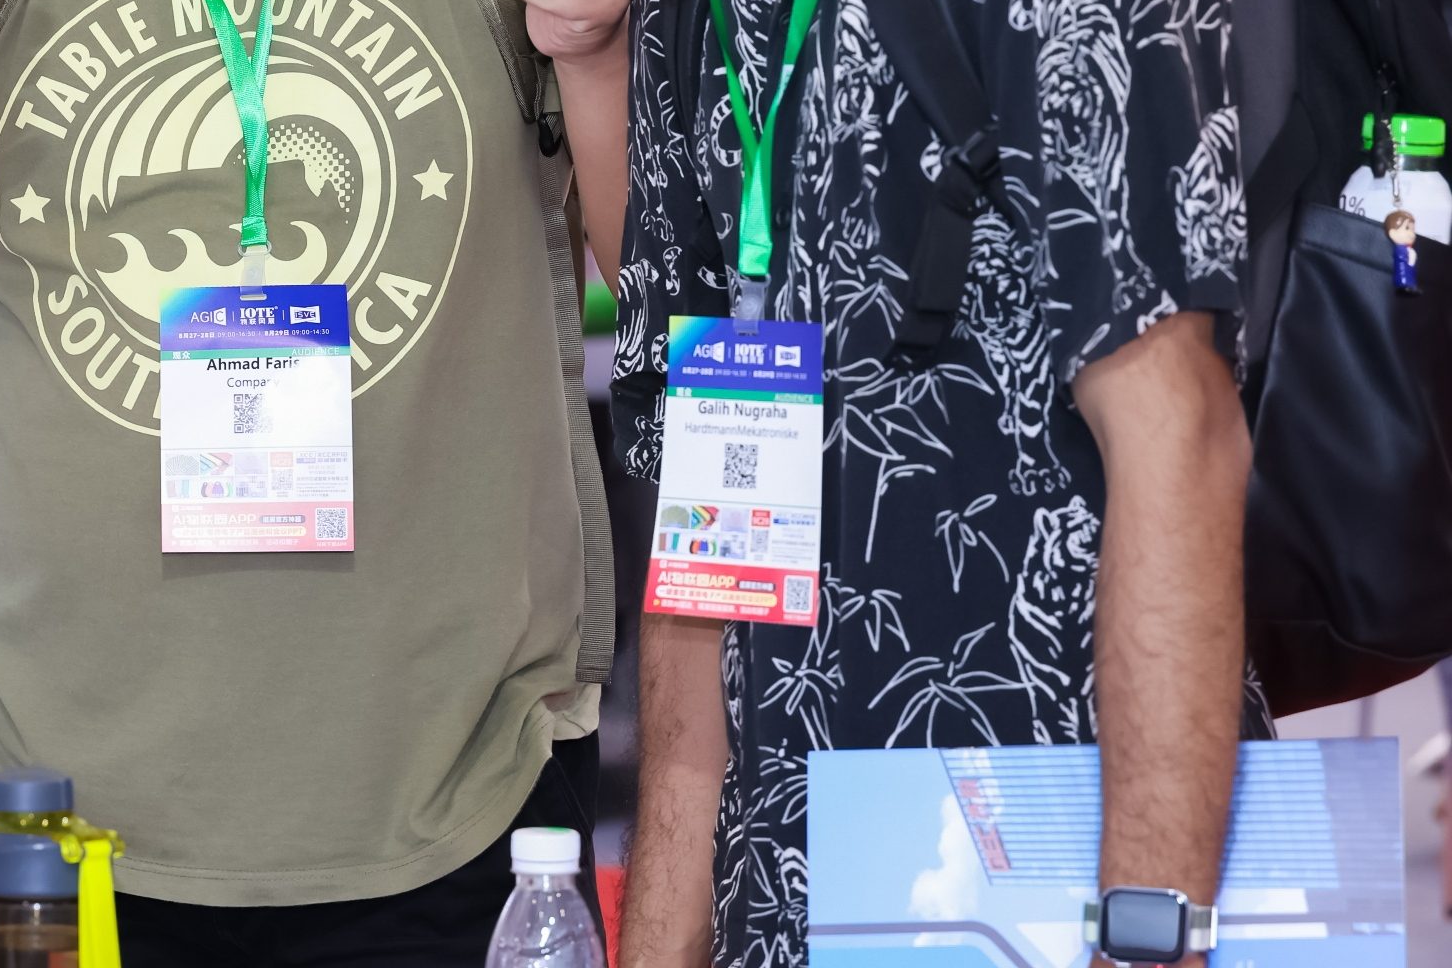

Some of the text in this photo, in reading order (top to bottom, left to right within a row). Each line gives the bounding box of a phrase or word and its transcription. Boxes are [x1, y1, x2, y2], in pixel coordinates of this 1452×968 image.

[15, 1, 158, 140] TABLE
[190, 307, 227, 327] AGIC
[239, 306, 275, 319] IOTE
[291, 347, 340, 357] AUDIENCE
[206, 356, 300, 371] Ahmad Faris
[698, 400, 788, 421] Galih Nugraha
